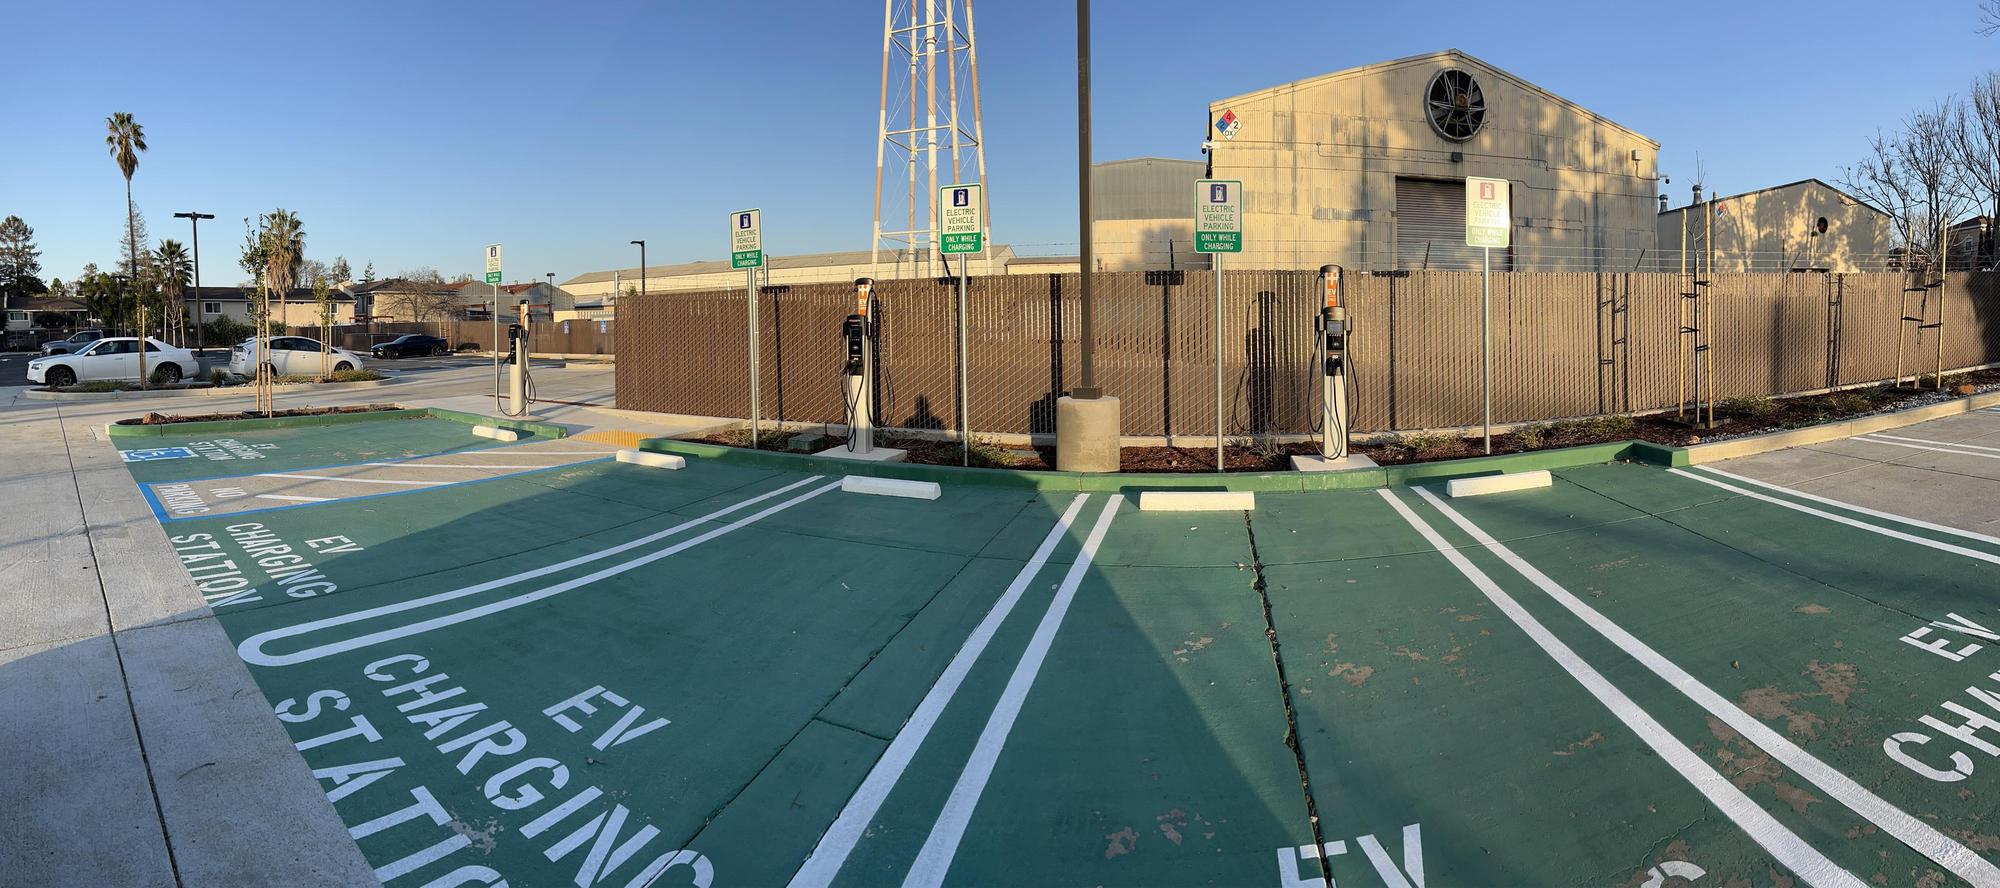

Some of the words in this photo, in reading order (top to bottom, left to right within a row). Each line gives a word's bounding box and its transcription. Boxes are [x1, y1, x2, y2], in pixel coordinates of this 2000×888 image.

[1233, 121, 1239, 129] 2
[946, 208, 975, 217] ELECTRIC
[1202, 205, 1235, 213] ELECTRIC
[947, 216, 975, 225] VEHICLE
[947, 224, 975, 232] PARKING
[735, 229, 757, 238] ELECTRIC
[736, 236, 756, 244] VEHICLE
[945, 235, 959, 243] ONLY
[736, 243, 757, 251] PARKING
[948, 243, 975, 251] CHARGING
[736, 259, 757, 267] CHARGING
[209, 486, 247, 498] NO
[156, 483, 210, 515] PARKING
[304, 535, 365, 554] EV
[225, 522, 337, 598] CHARGING
[170, 533, 263, 609] STATION
[1899, 612, 2000, 662] EV
[542, 684, 671, 751] EV
